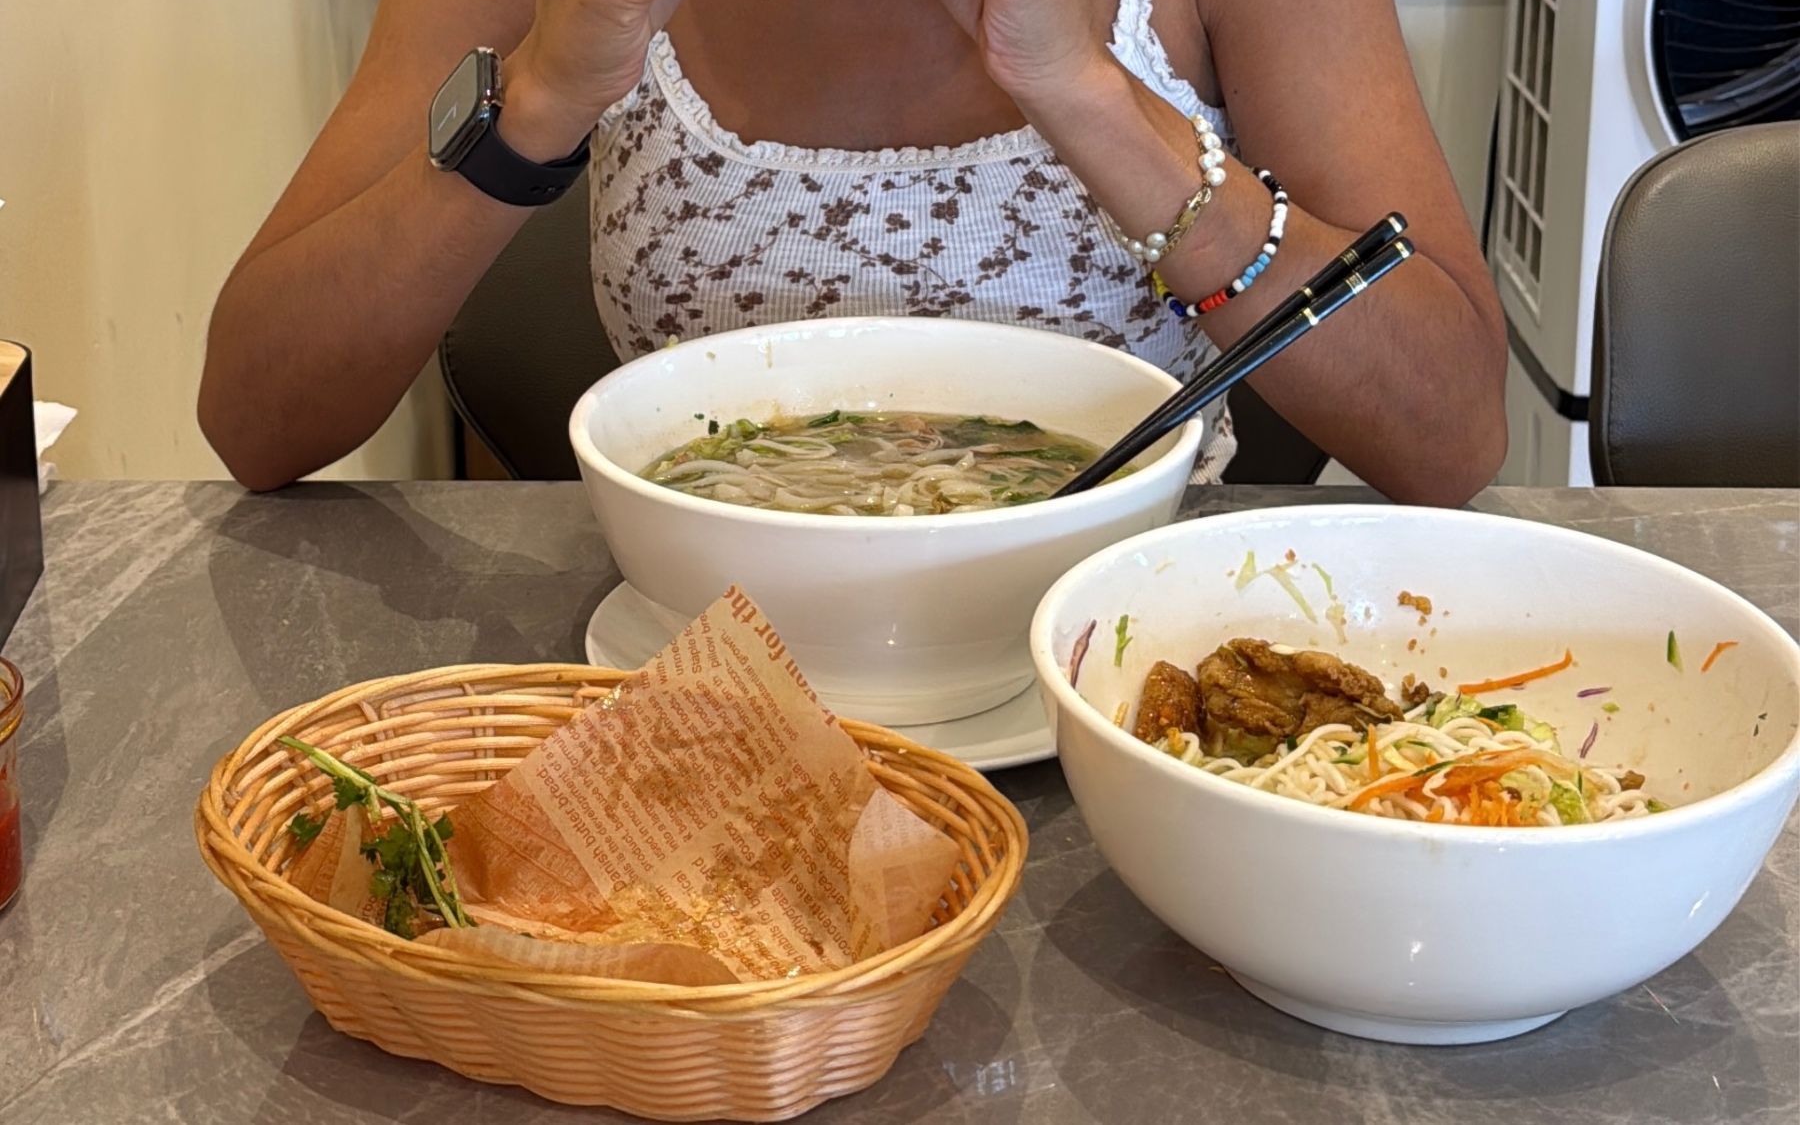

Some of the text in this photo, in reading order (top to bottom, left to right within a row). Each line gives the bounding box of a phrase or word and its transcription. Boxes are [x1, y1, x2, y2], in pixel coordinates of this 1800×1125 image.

[702, 633, 722, 670] pillow
[750, 619, 790, 662] for
[685, 636, 703, 675] Staple
[655, 659, 669, 685] with
[719, 685, 734, 701] on
[639, 713, 653, 726] is
[716, 710, 736, 730] and
[730, 700, 756, 732] aroma
[776, 714, 786, 725] a
[780, 722, 800, 741] get
[544, 751, 554, 760] a
[548, 760, 563, 773] of
[576, 768, 594, 788] the
[594, 765, 615, 787] and
[700, 771, 719, 792] Pie
[721, 772, 743, 797] cake
[557, 770, 608, 836] development
[713, 789, 731, 809] the
[620, 799, 642, 827] more
[561, 806, 597, 848] butter
[636, 825, 650, 838] in
[656, 823, 666, 832] a
[806, 823, 830, 853] East
[601, 834, 620, 854] the
[618, 828, 654, 872] product,
[643, 834, 666, 861] used
[659, 830, 680, 853] into
[721, 819, 756, 862] source
[614, 851, 627, 863] is
[776, 858, 793, 876] in
[588, 845, 628, 893] Danish
[653, 884, 678, 911] from
[753, 906, 773, 926] for
[766, 923, 798, 958] habits
